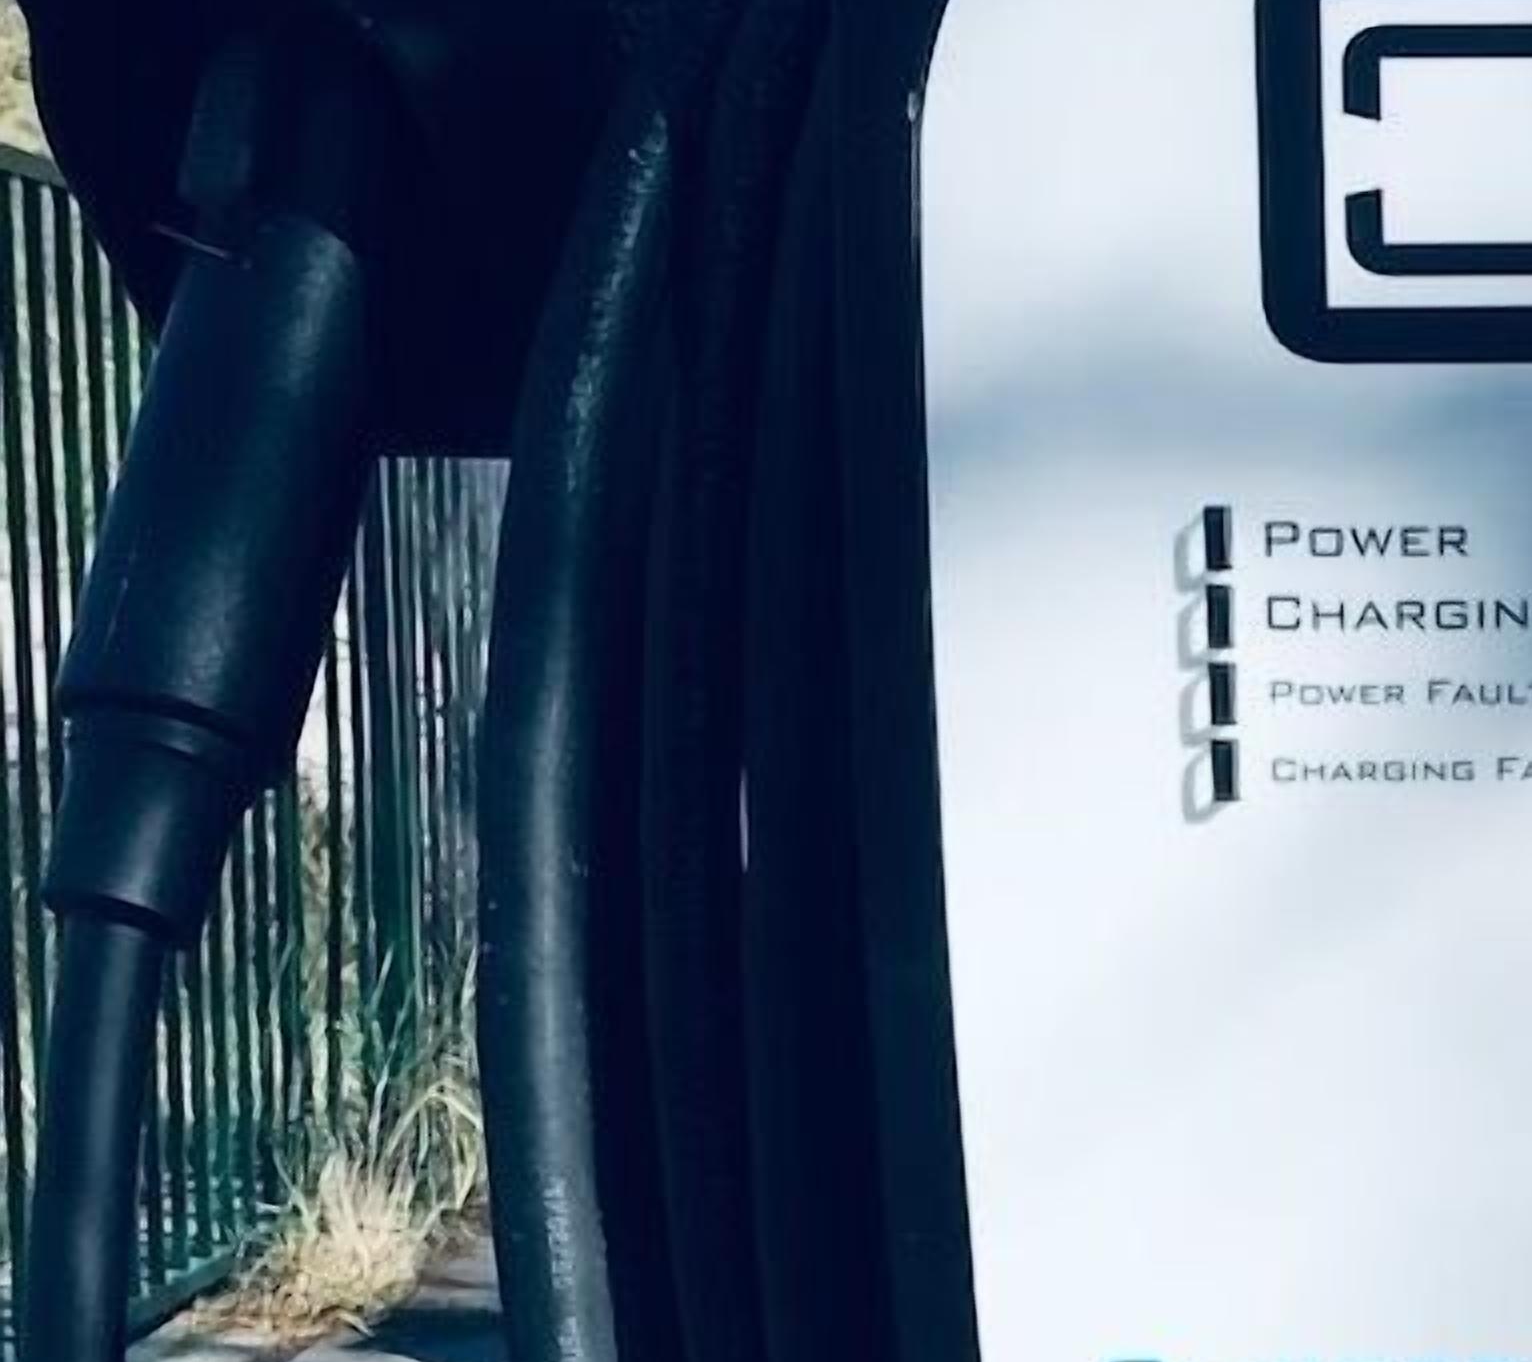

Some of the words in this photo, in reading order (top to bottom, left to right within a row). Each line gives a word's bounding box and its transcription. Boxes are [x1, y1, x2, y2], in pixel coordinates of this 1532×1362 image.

[1264, 521, 1468, 557] POWER
[1270, 680, 1405, 705] POWER
[1272, 758, 1475, 782] CHARGING
